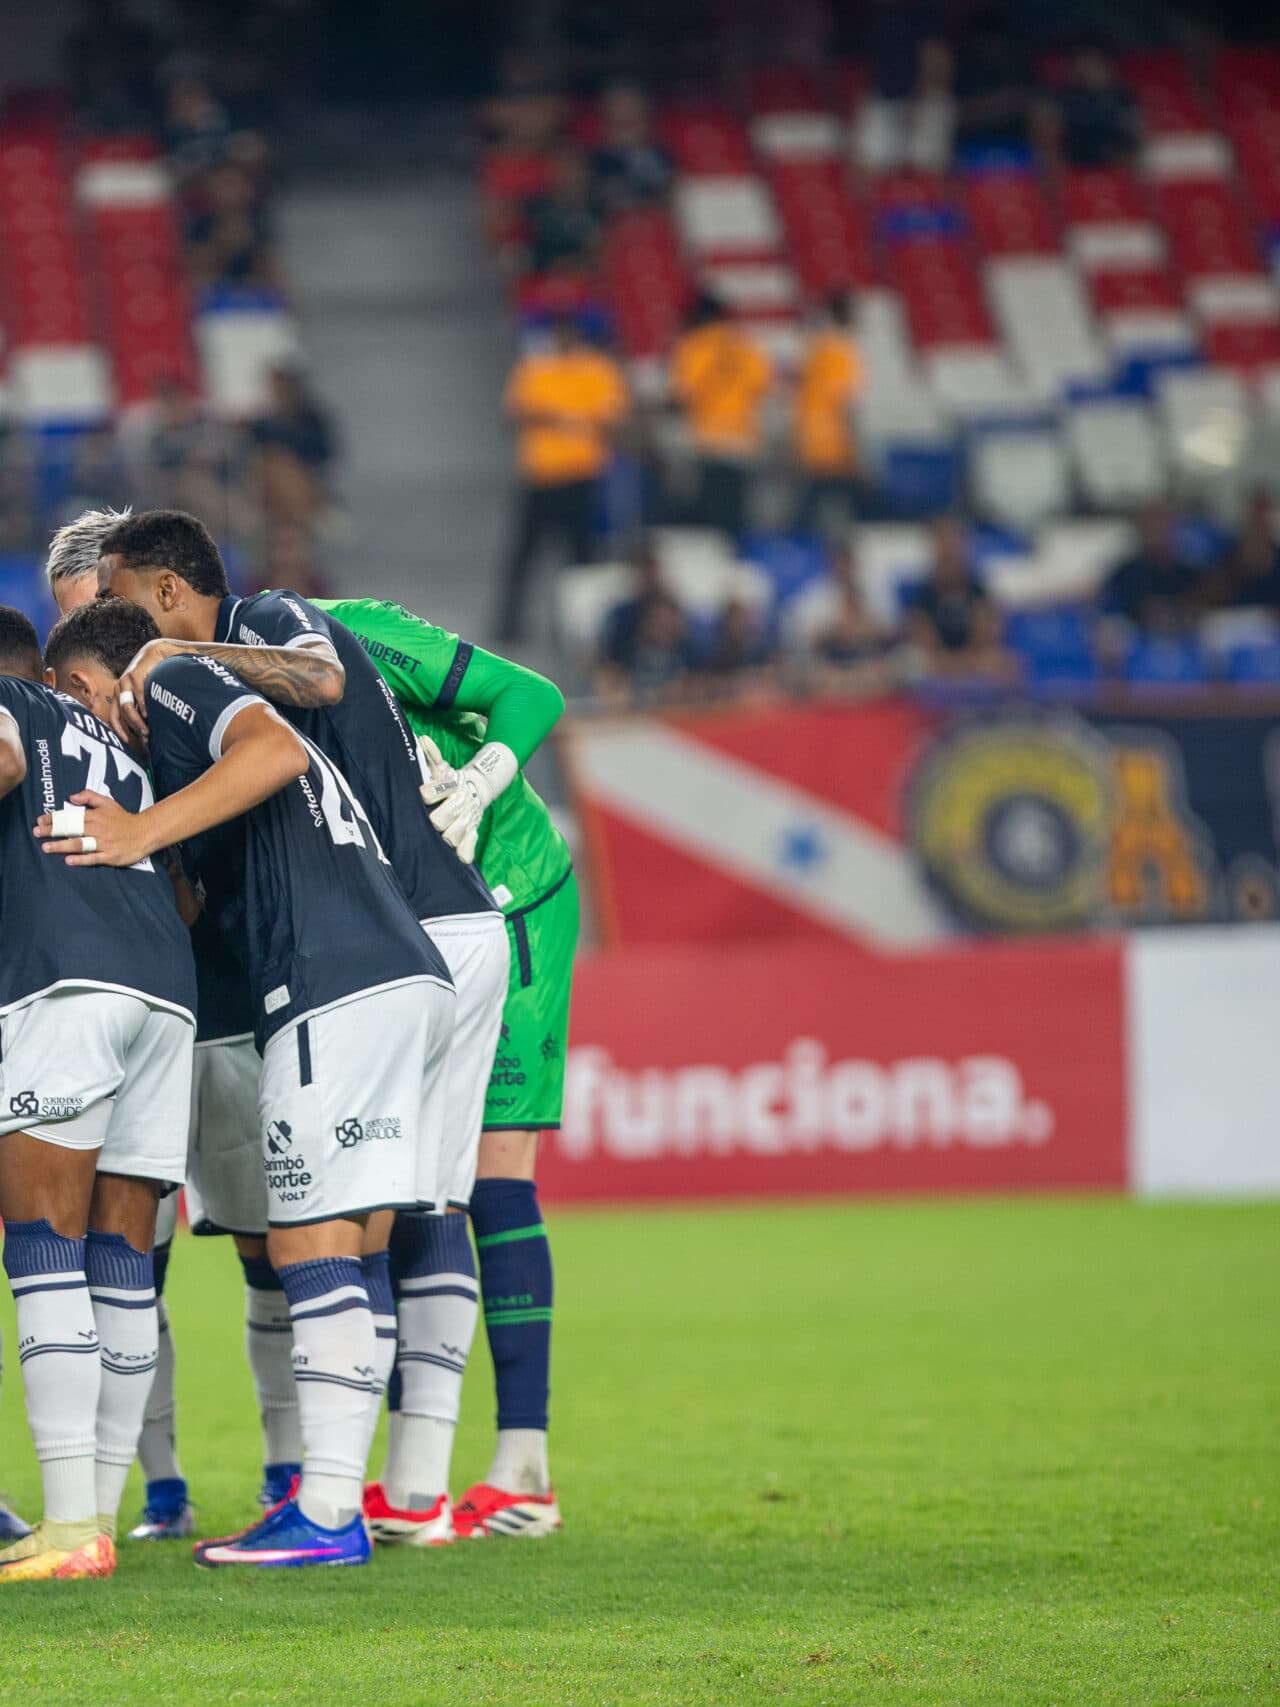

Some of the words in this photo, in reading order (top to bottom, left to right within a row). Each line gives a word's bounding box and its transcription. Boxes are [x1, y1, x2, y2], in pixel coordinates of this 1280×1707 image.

[150, 681, 196, 725] VAIDEBET
[35, 738, 56, 809] fatalmodel
[265, 1154, 305, 1171] arimbó
[278, 1190, 308, 1203] VOLT
